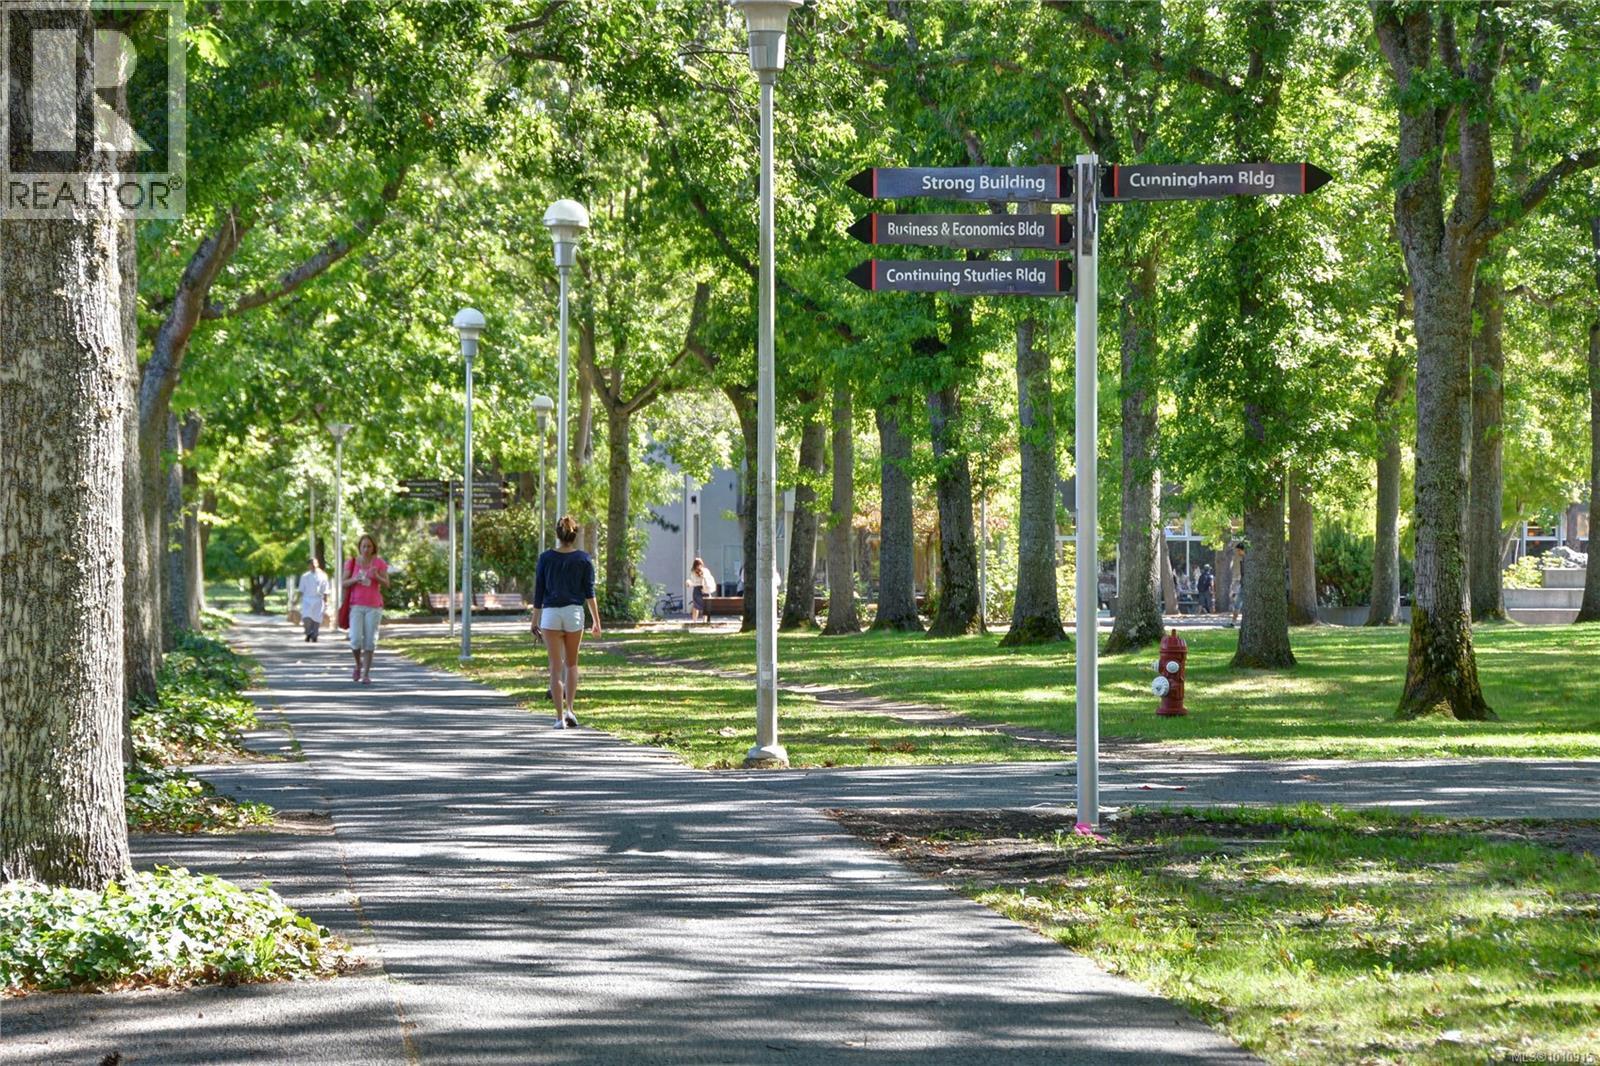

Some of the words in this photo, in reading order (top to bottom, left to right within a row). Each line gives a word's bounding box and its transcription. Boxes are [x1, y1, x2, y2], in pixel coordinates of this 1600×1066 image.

[922, 175, 975, 193] Strong
[980, 175, 1045, 192] Building
[1129, 171, 1233, 189] Cunningham
[1238, 170, 1275, 188] Bldg
[887, 222, 938, 236] Business
[941, 222, 950, 235] &
[952, 222, 1015, 236] Economics
[1018, 221, 1045, 237] Bldg
[886, 268, 961, 286] Continuing
[964, 268, 1012, 282] Studies
[1016, 267, 1046, 284] Bldg
